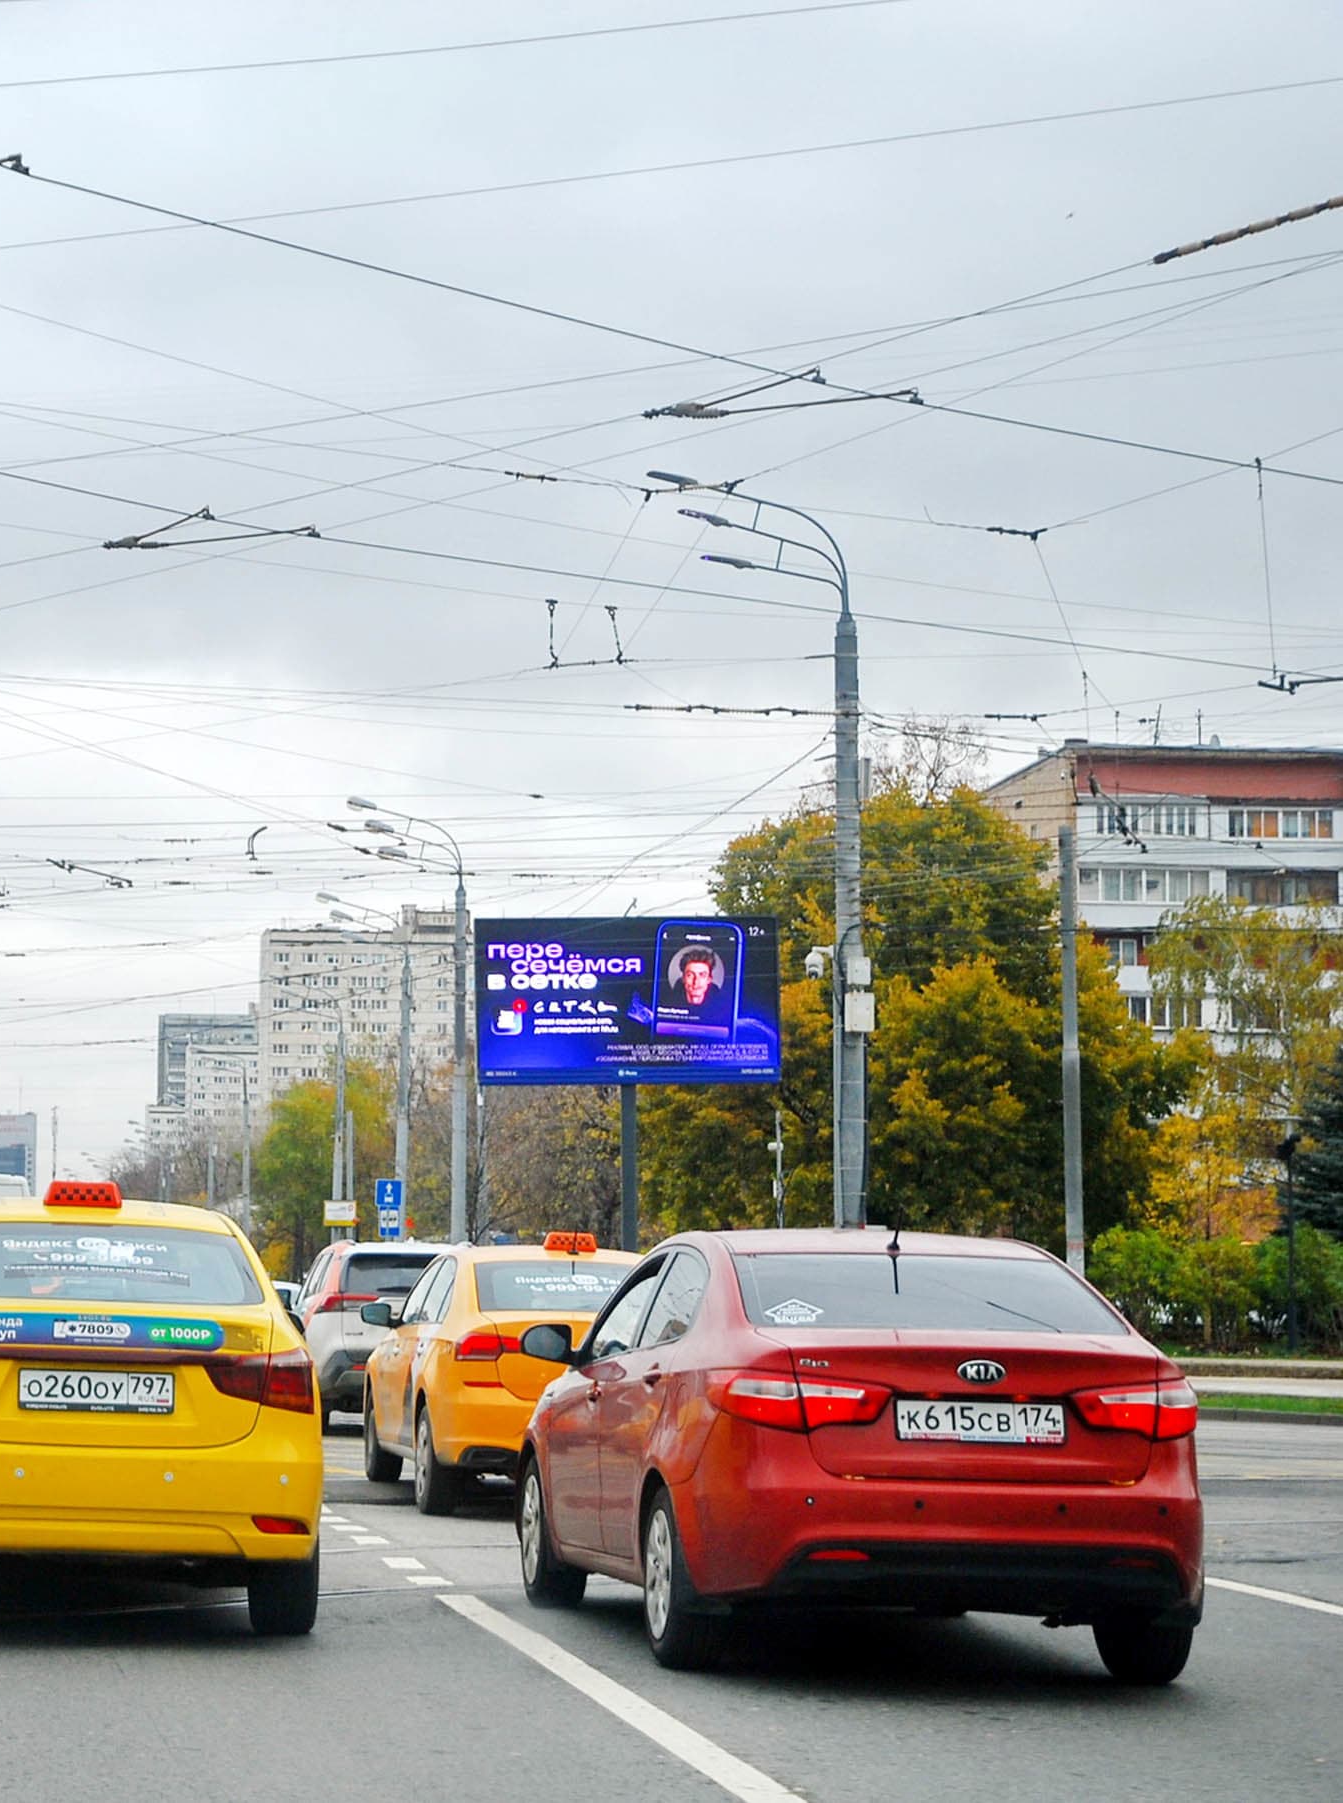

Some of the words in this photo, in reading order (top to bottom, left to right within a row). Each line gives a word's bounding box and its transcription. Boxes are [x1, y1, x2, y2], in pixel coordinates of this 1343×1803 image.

[487, 943, 563, 962] пере
[511, 953, 642, 973] сечёмся
[151, 1329, 167, 1337] от
